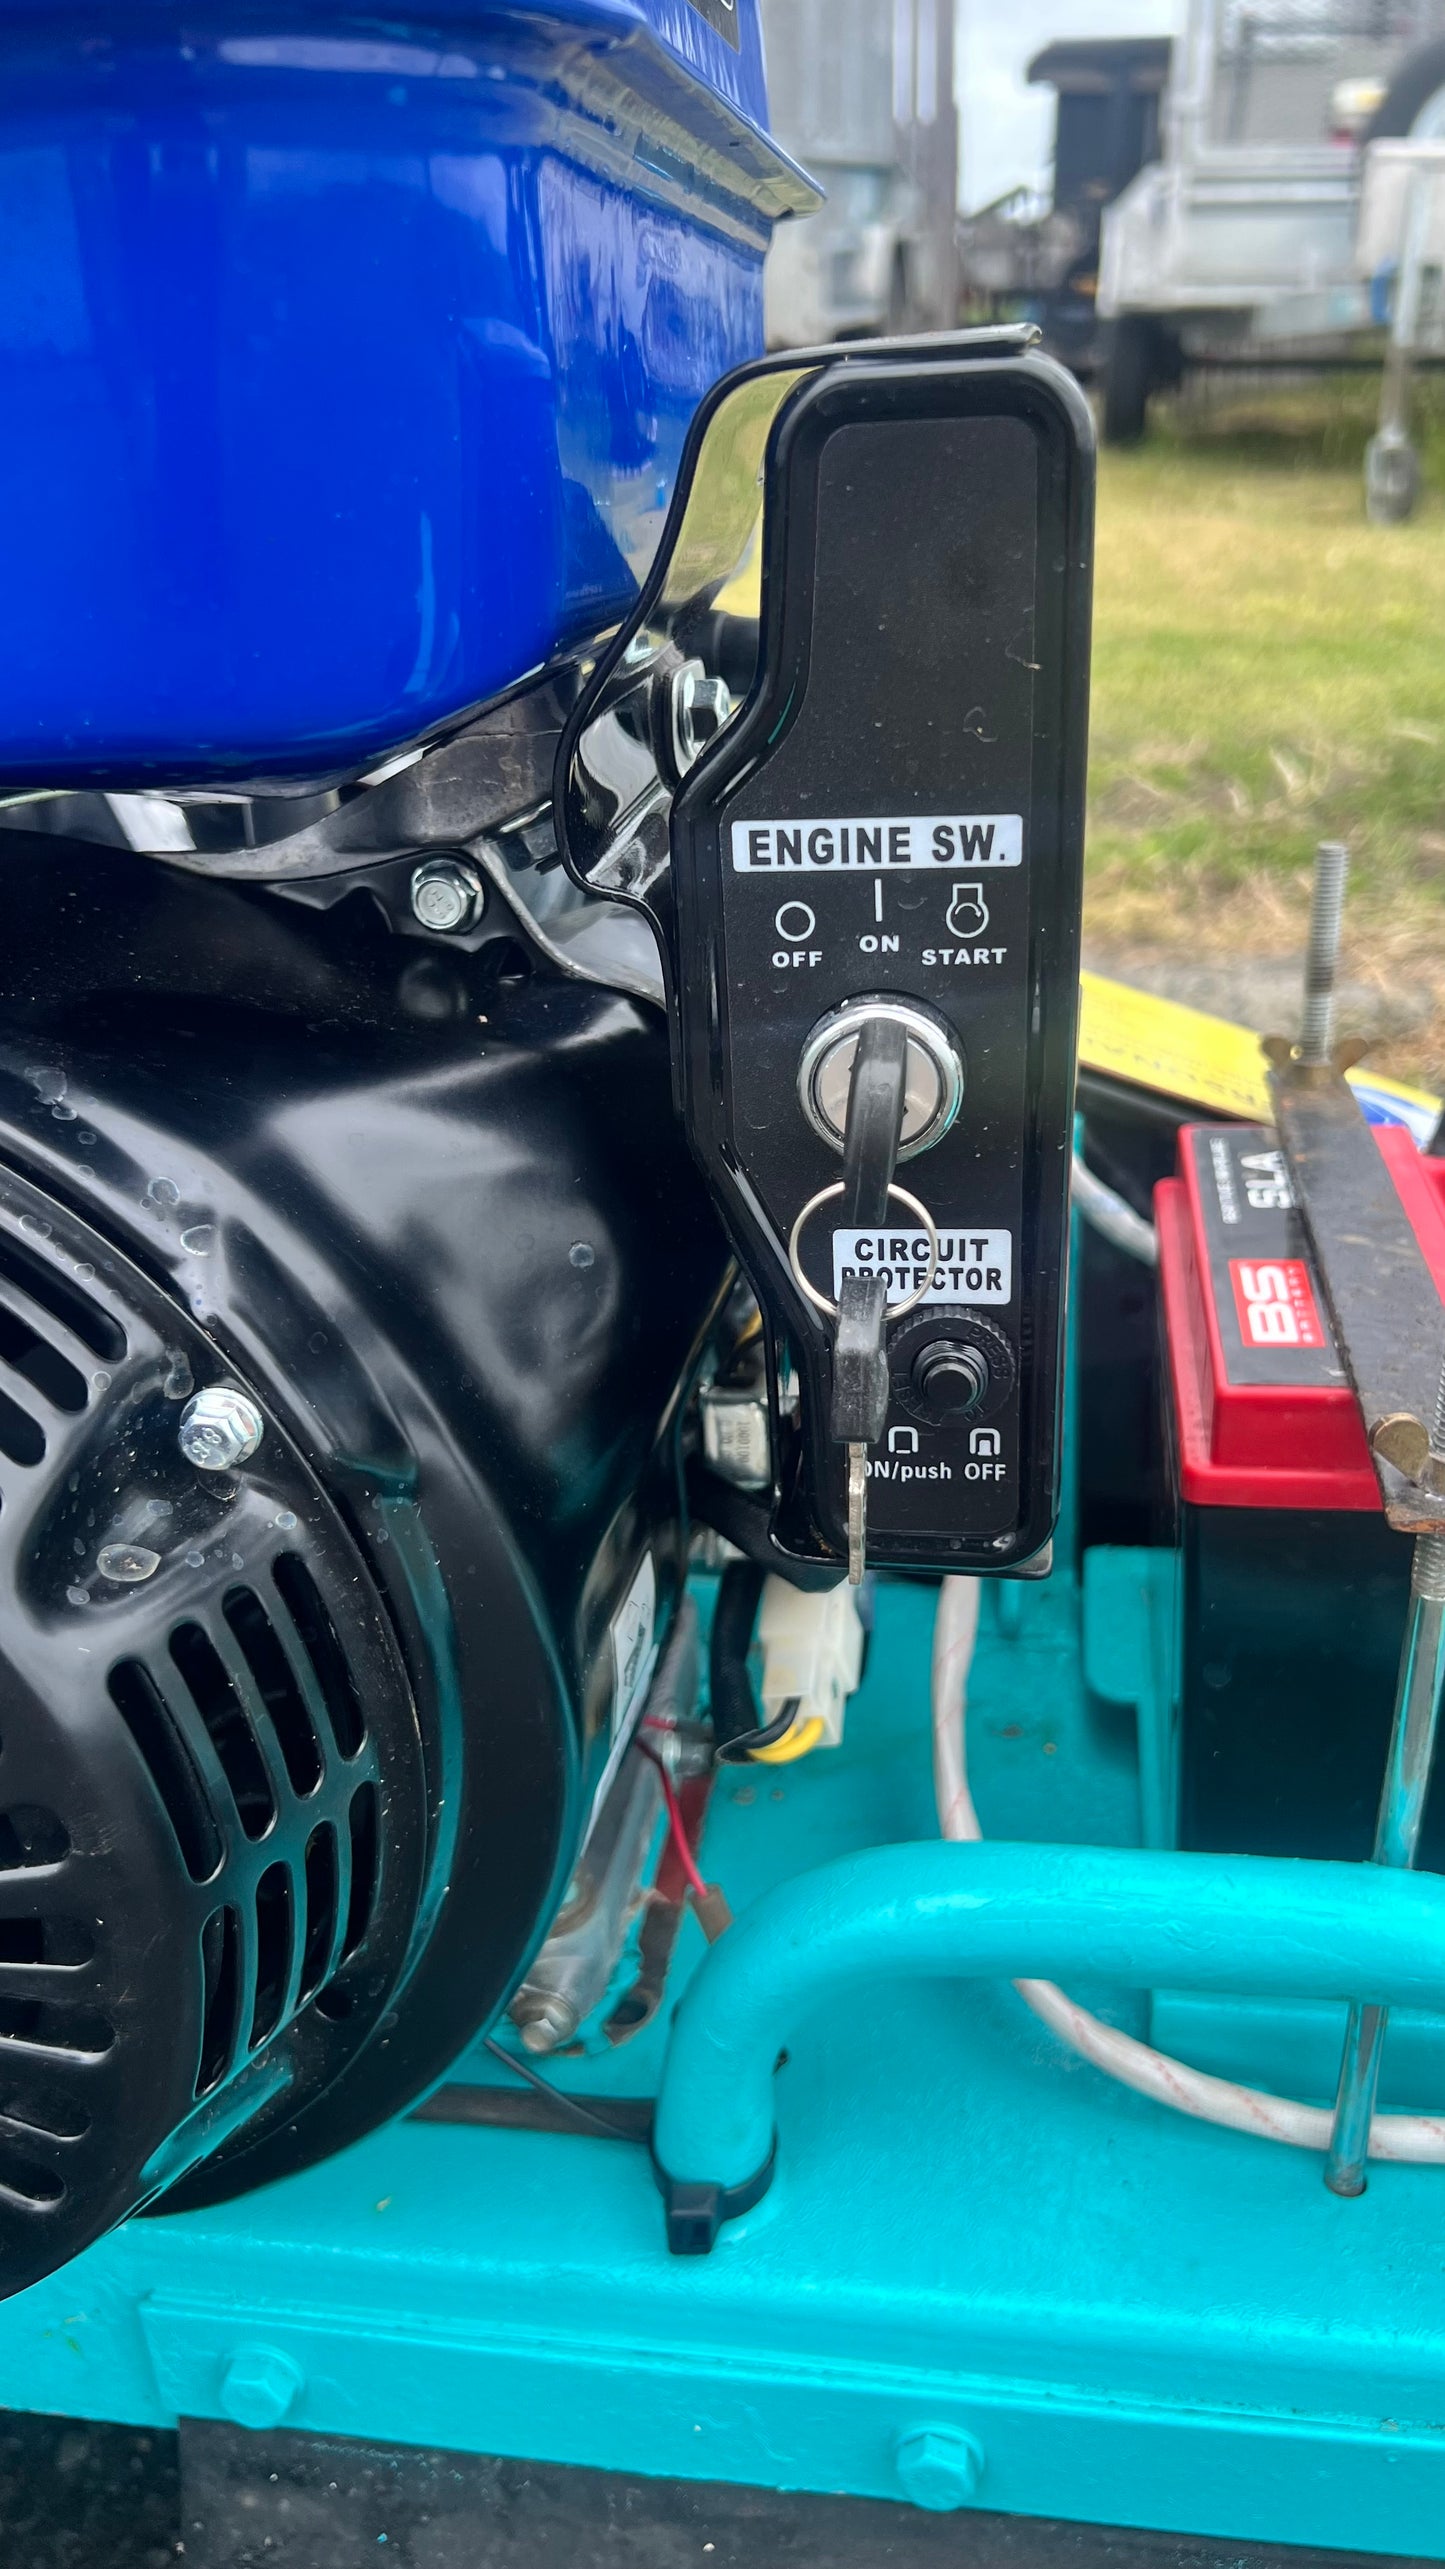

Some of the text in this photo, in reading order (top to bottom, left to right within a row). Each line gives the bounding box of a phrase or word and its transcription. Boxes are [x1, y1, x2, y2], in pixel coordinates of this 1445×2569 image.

[748, 824, 1005, 865] ENGINE SW.
[858, 934, 900, 953] ON
[771, 951, 823, 968] OFF
[921, 947, 1008, 966] START
[1240, 1150, 1293, 1209] SLA
[854, 1238, 989, 1262] CIRCUIT
[1239, 1264, 1299, 1343] BS
[964, 1462, 1007, 1481] OFF
